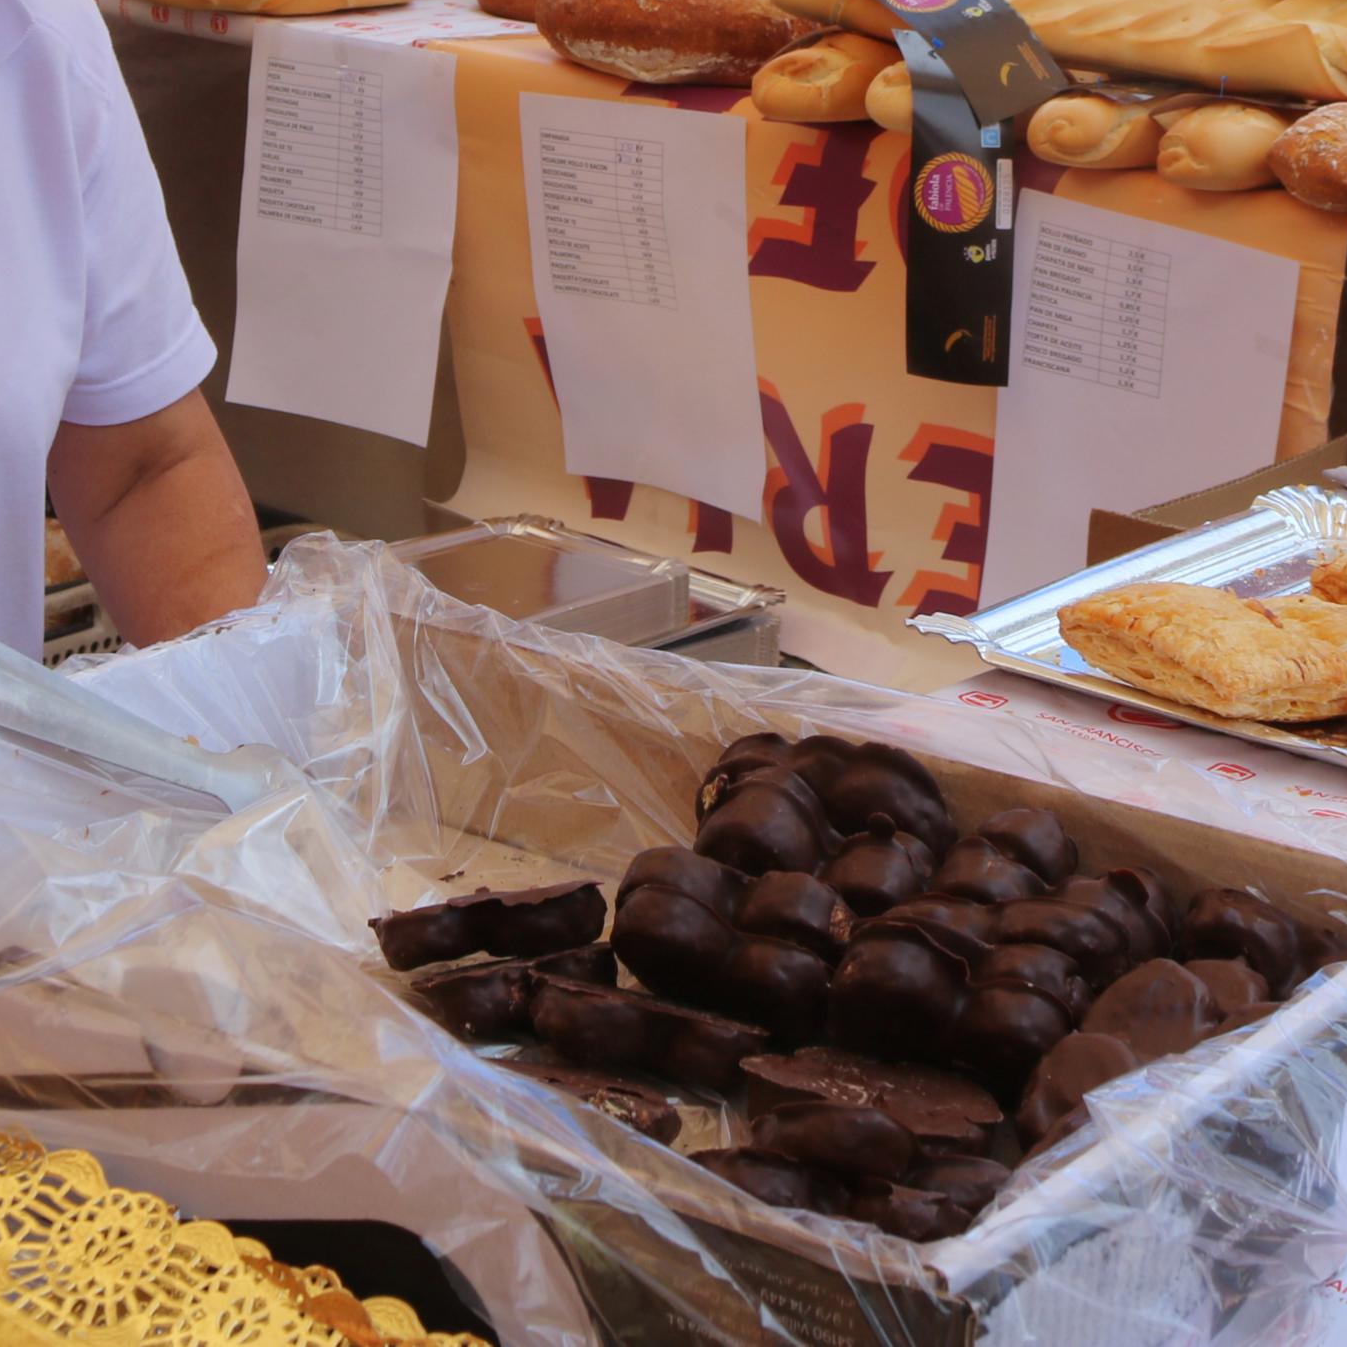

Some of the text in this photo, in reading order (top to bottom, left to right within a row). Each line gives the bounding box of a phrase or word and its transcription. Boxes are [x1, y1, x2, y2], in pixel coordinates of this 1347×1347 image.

[927, 173, 941, 212] fabiola
[945, 173, 953, 212] PALENCIA
[1038, 240, 1051, 249] PAN
[1029, 305, 1043, 314] PAN
